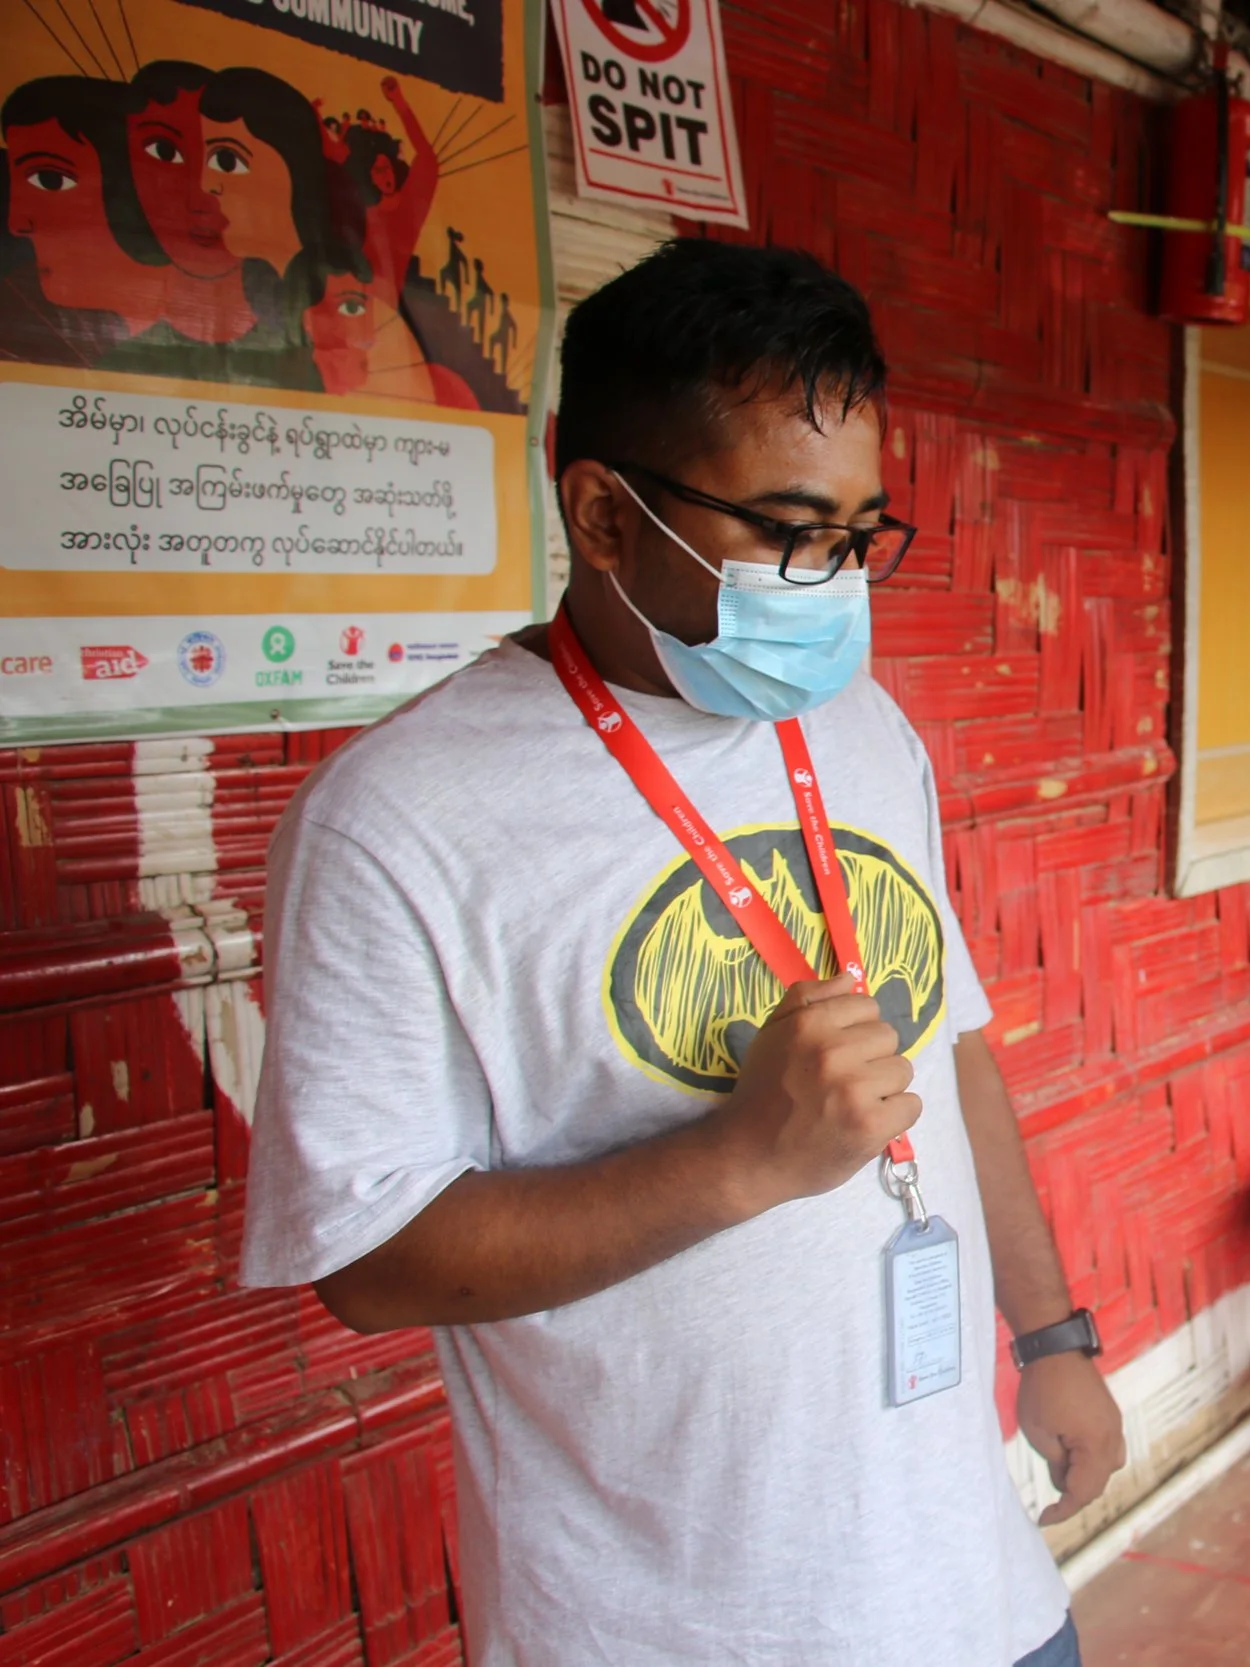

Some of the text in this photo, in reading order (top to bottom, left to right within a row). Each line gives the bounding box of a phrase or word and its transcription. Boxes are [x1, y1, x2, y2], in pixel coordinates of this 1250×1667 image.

[580, 51, 706, 110] DO NOT
[588, 94, 709, 166] SPIT
[1, 655, 53, 675] care
[96, 650, 139, 677] aid
[256, 671, 302, 687] OXFAM
[673, 806, 735, 886] Save the Children
[804, 791, 831, 876] Save the Children
